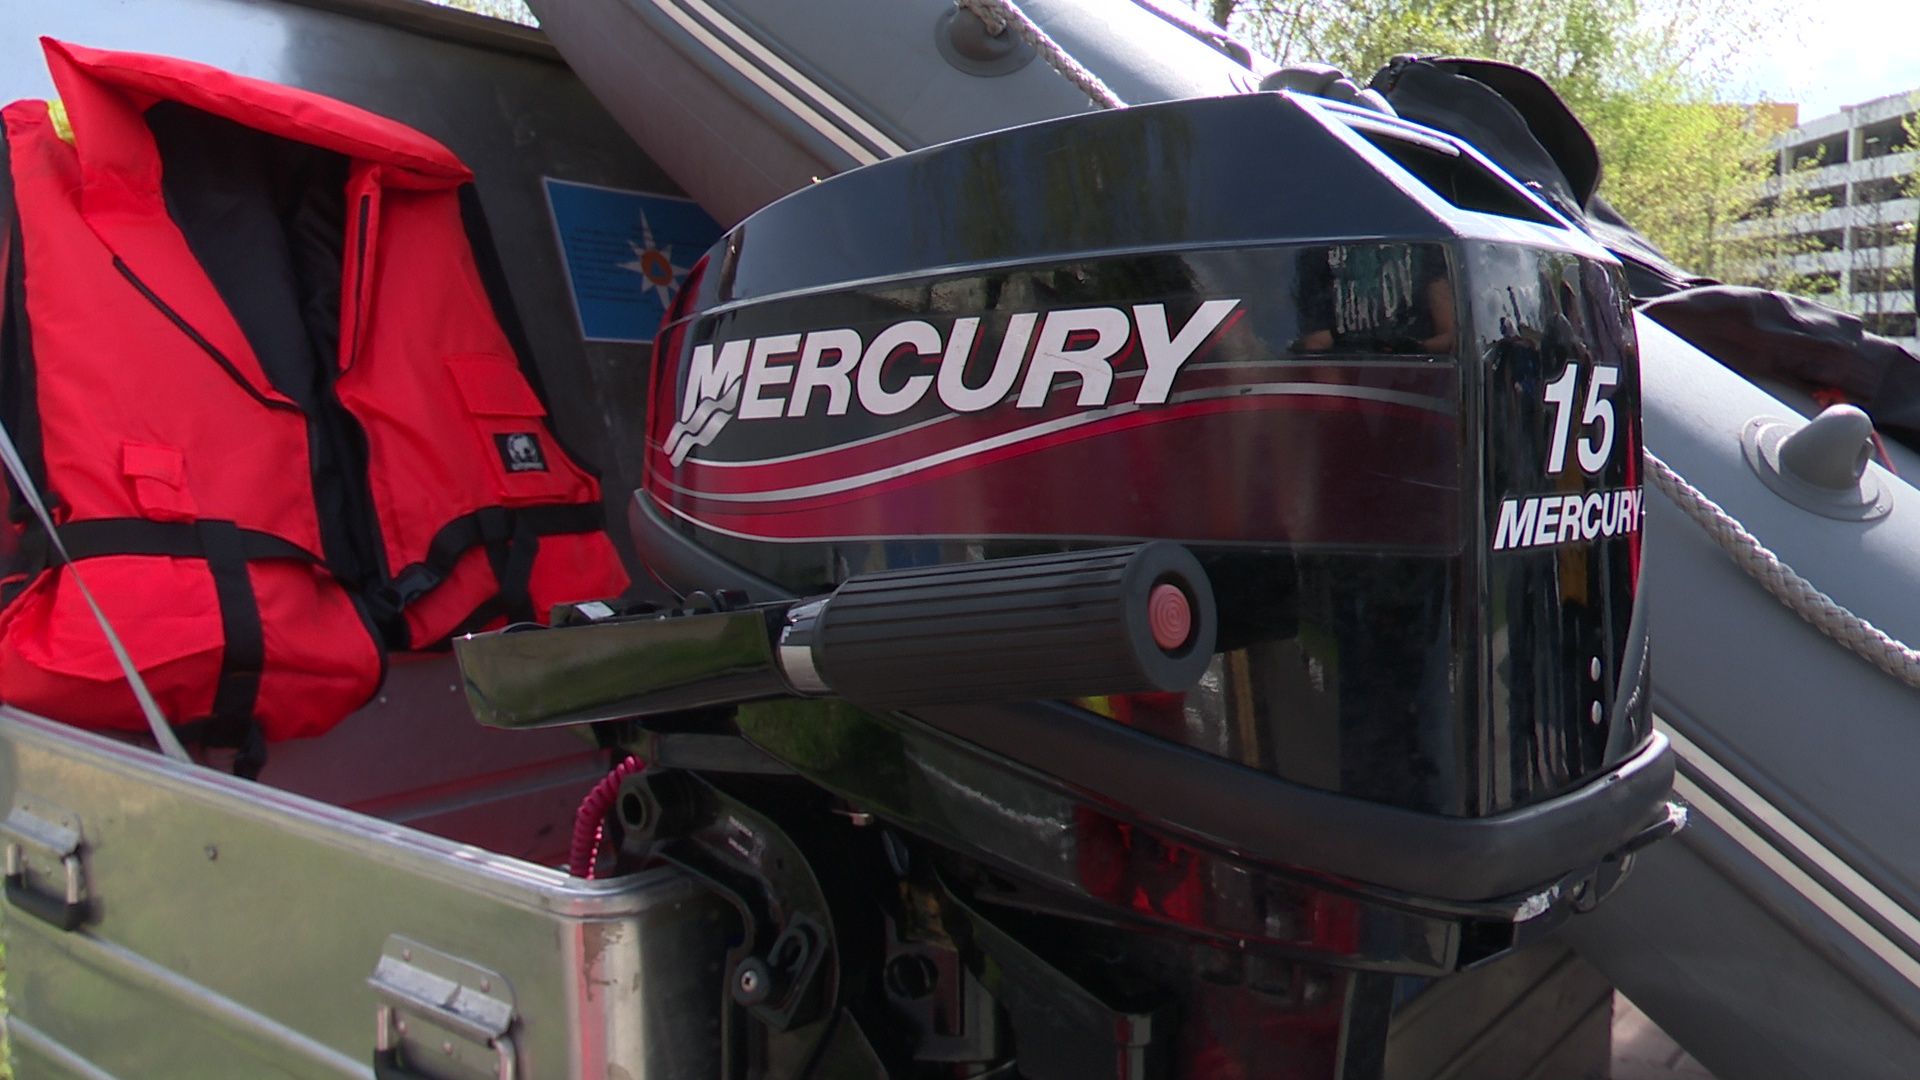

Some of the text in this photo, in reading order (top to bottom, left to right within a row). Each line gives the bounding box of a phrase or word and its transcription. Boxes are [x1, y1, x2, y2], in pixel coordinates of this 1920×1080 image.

[664, 298, 1241, 466] MERCURY
[1544, 363, 1618, 473] 15
[1493, 488, 1643, 549] MERCURY
